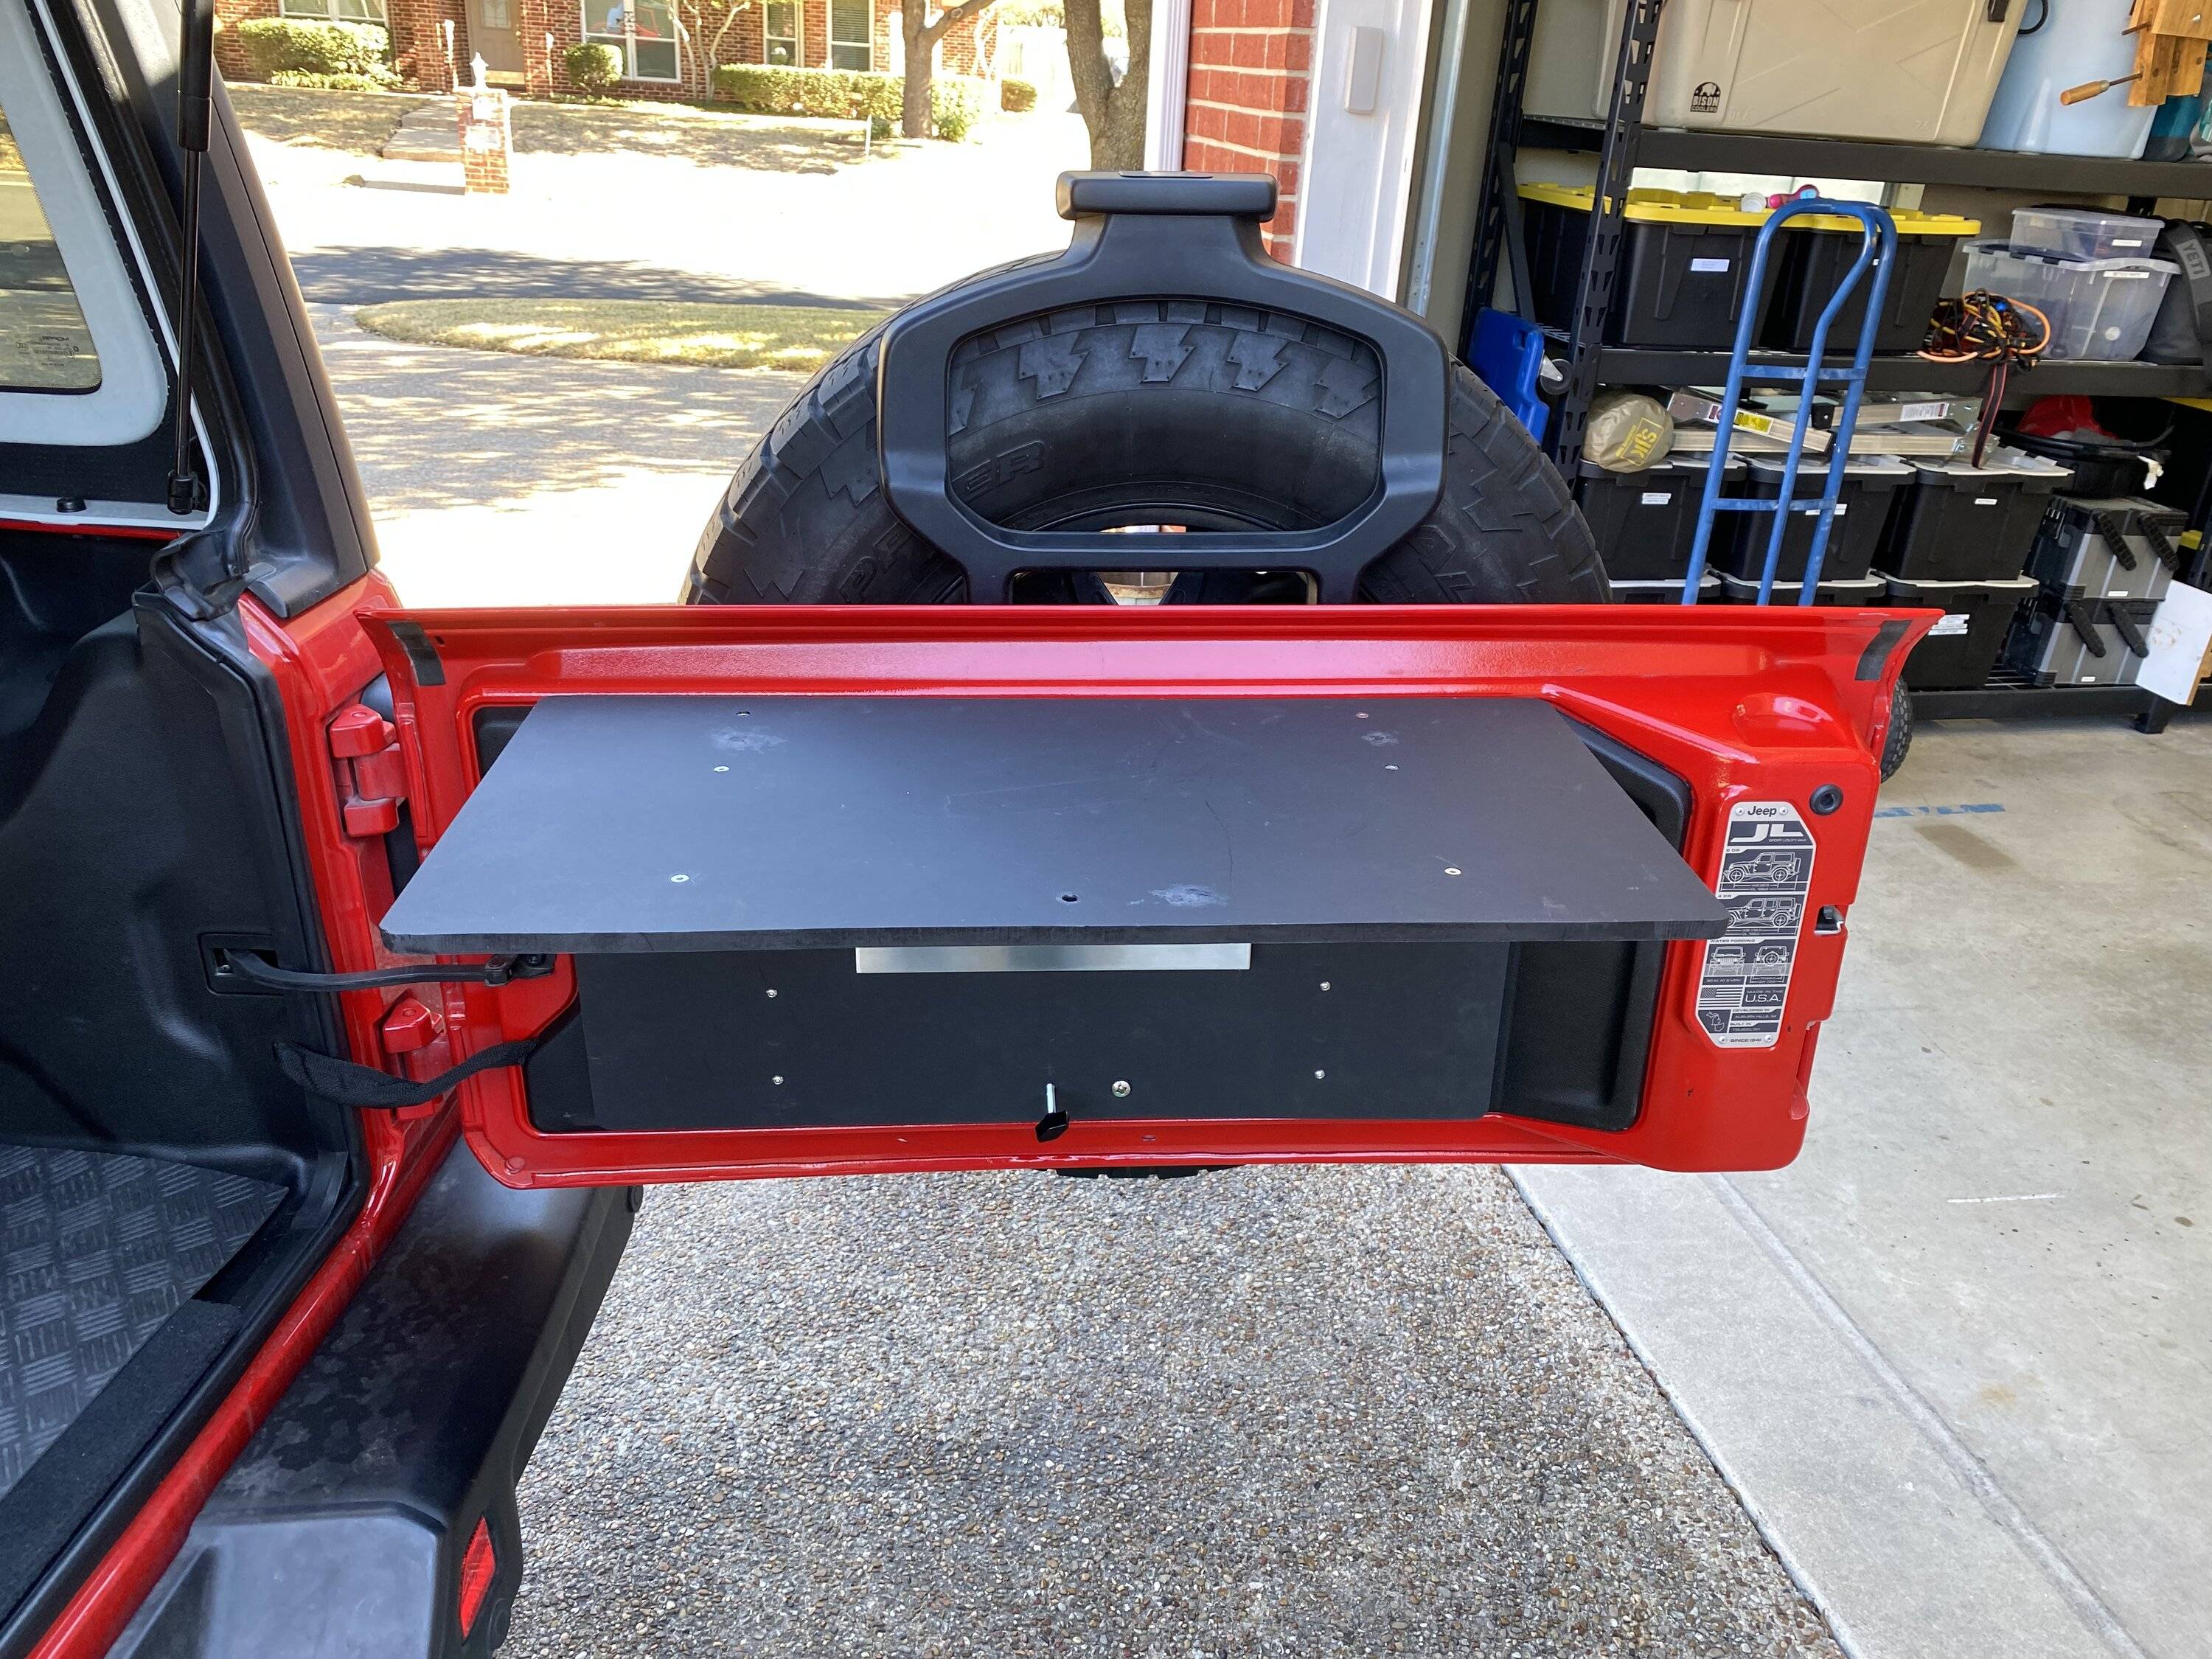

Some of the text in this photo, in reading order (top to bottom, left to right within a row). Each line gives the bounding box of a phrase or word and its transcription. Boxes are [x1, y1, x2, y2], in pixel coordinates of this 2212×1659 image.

[1693, 95, 1719, 106] BISON
[2183, 242, 2206, 275] YETI
[1747, 805, 1777, 818] Jeep
[1730, 823, 1804, 843] JL
[1745, 994, 1781, 1003] U.S.A.
